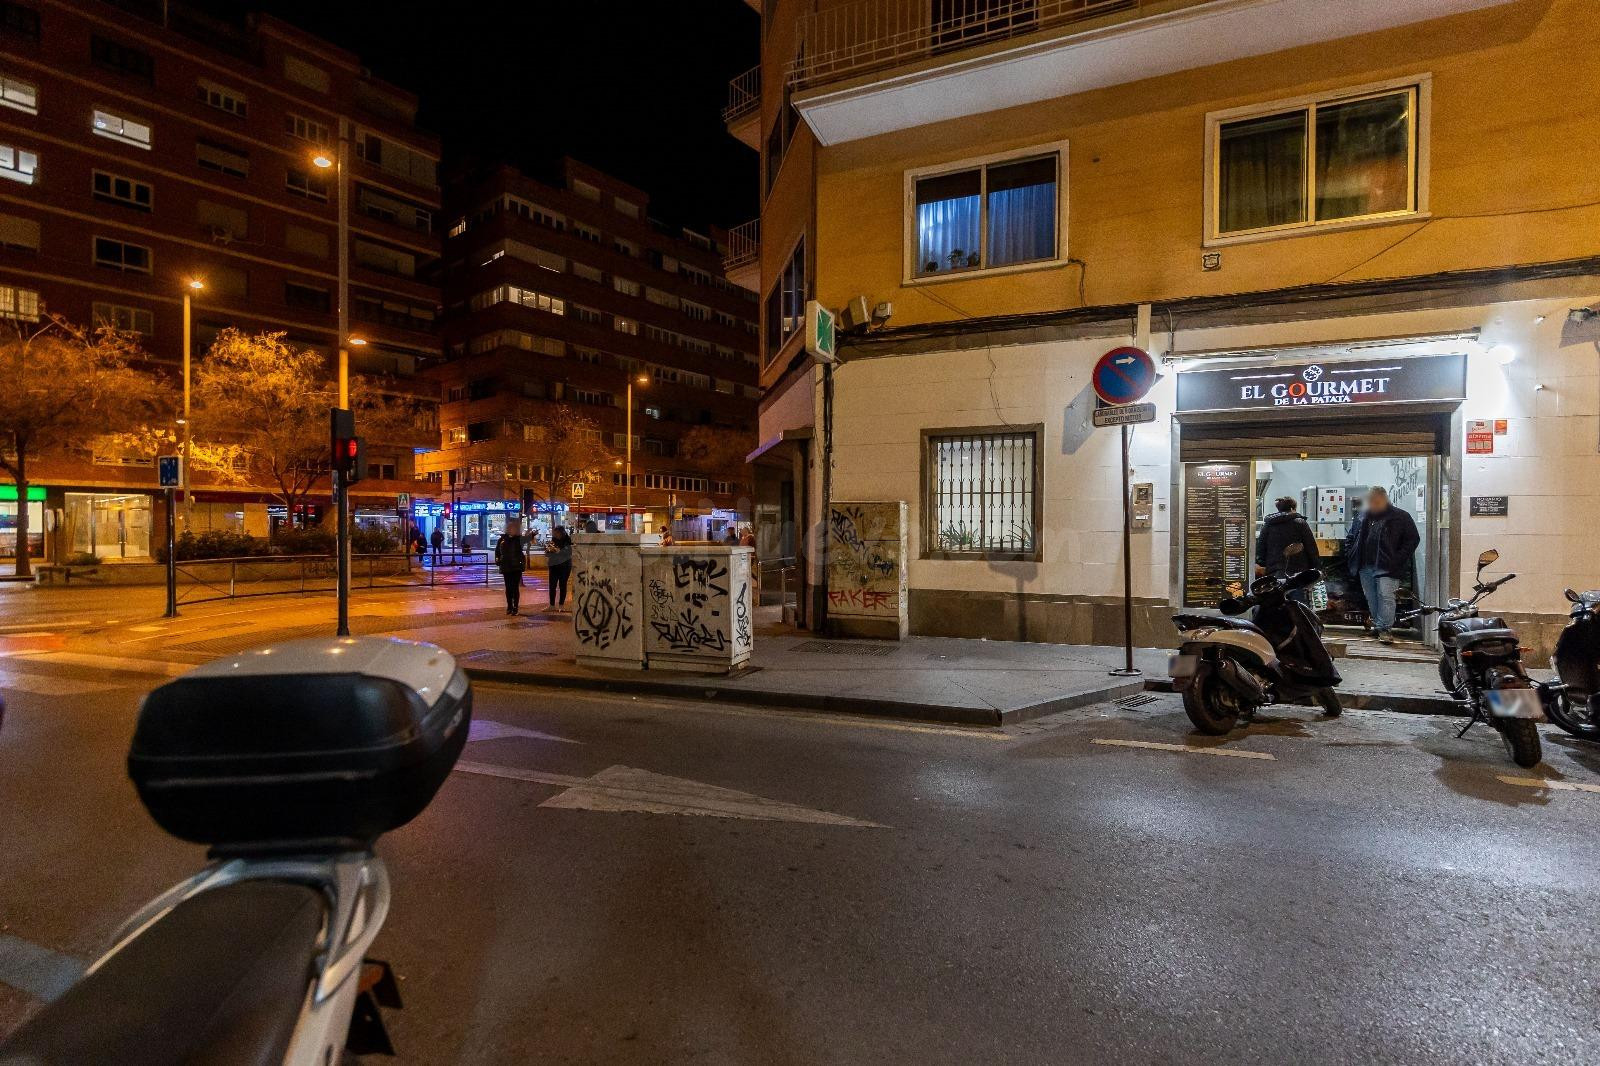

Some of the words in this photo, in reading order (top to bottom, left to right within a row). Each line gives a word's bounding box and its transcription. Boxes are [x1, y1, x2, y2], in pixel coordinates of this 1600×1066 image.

[1241, 385, 1265, 400] EL
[1270, 378, 1390, 399] GOURMET
[1274, 397, 1290, 406] DE
[1293, 396, 1308, 405] LA
[1311, 394, 1351, 404] PATATA
